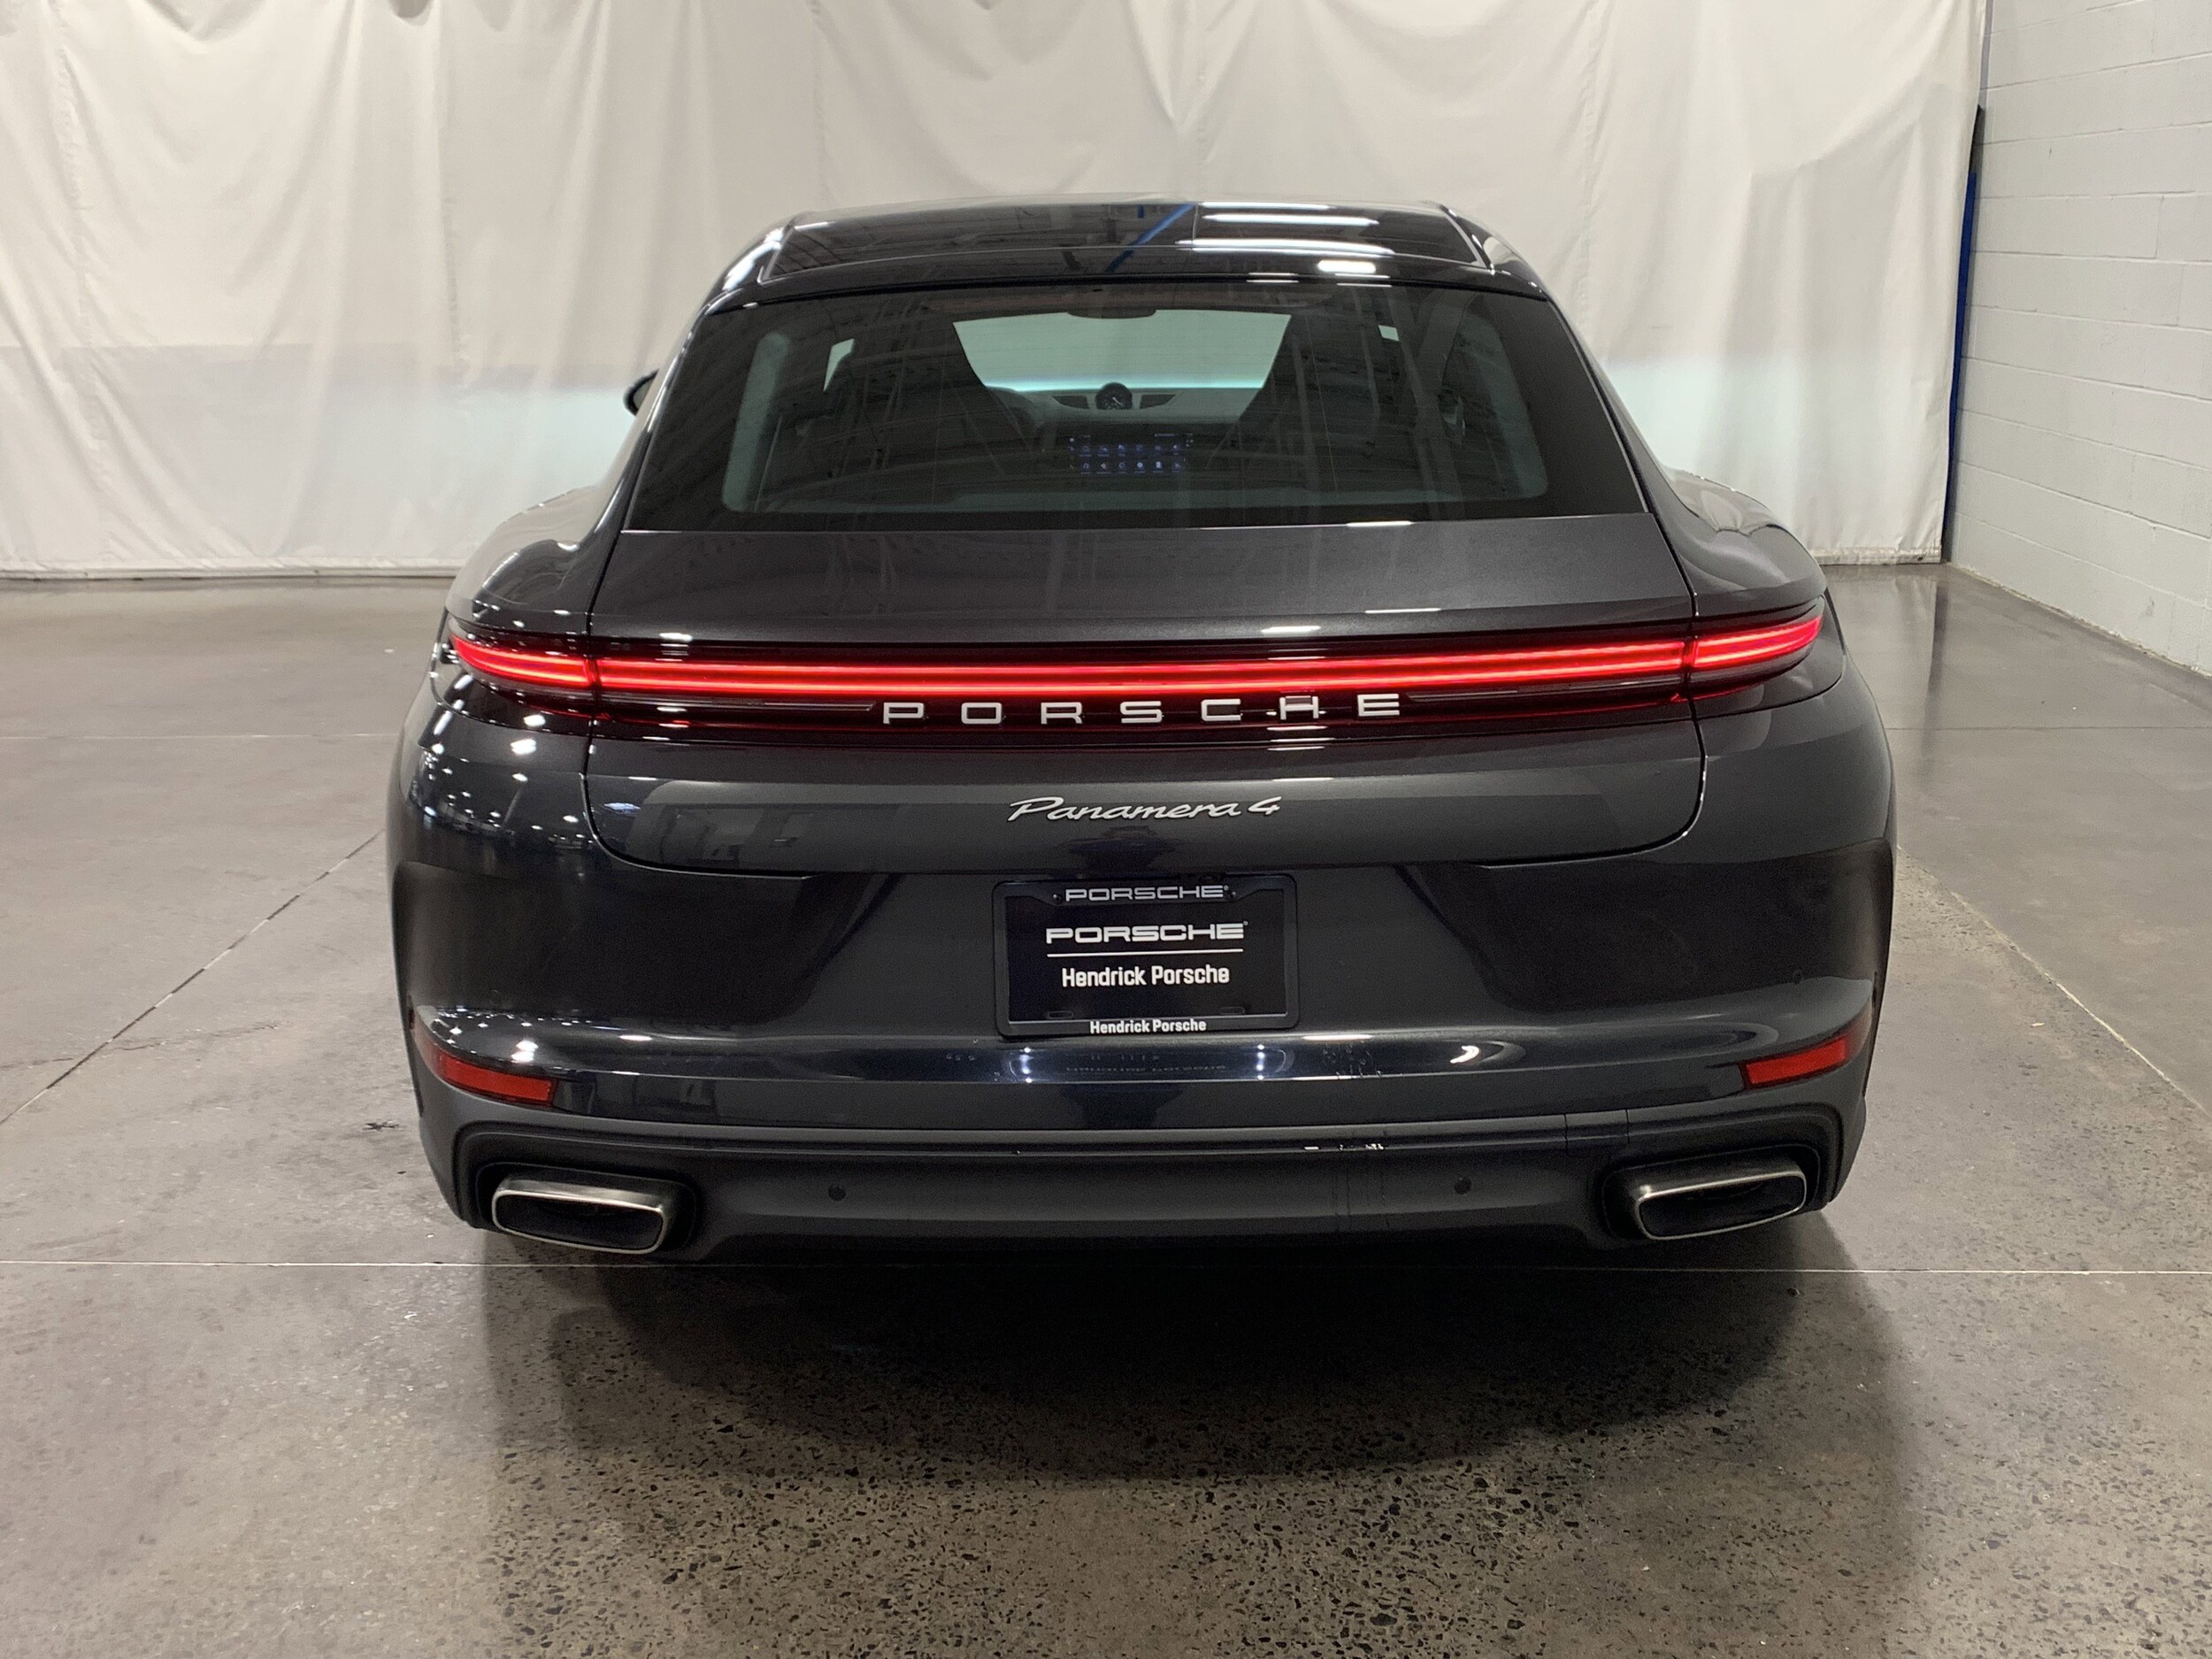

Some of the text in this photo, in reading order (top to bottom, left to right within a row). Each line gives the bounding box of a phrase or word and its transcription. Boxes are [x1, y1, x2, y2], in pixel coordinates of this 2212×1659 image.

[883, 693, 1401, 725] PORSCHE
[1007, 795, 1282, 822] Panamera 4
[1065, 885, 1224, 902] PORSCHE
[1046, 923, 1244, 944] PORSCHE
[1062, 964, 1230, 987] Hendrick Porsche
[1089, 1018, 1207, 1034] Hendrick Porsche
